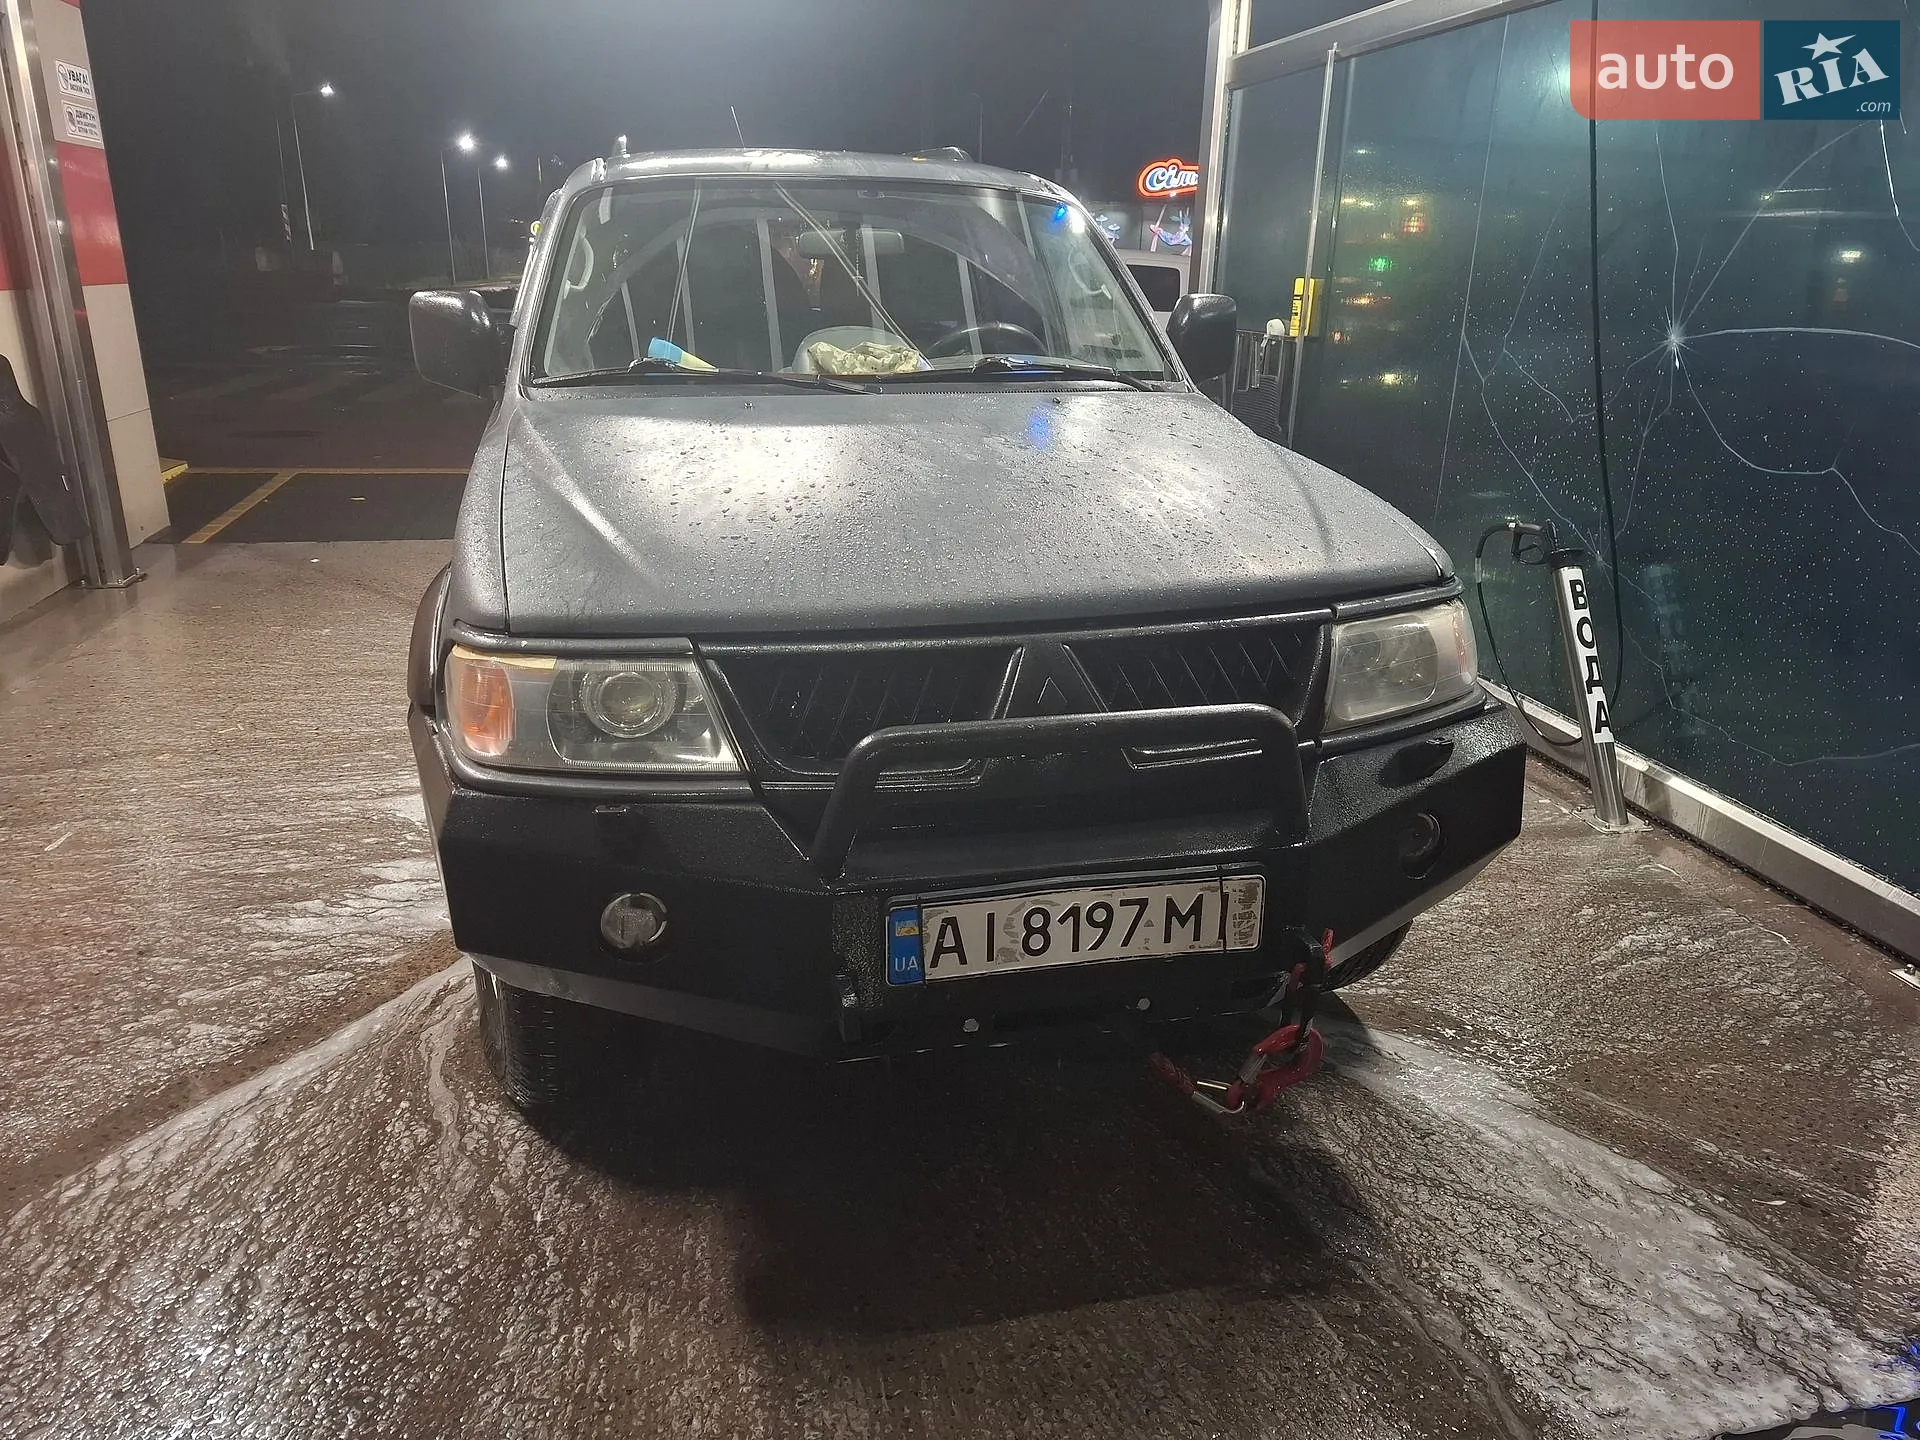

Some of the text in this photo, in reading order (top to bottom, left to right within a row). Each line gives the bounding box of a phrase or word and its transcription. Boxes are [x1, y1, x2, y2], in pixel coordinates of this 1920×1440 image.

[1569, 579, 1613, 734] ВОДА
[894, 957, 919, 972] UA
[929, 912, 995, 969] AI
[1021, 898, 1150, 957] 8197
